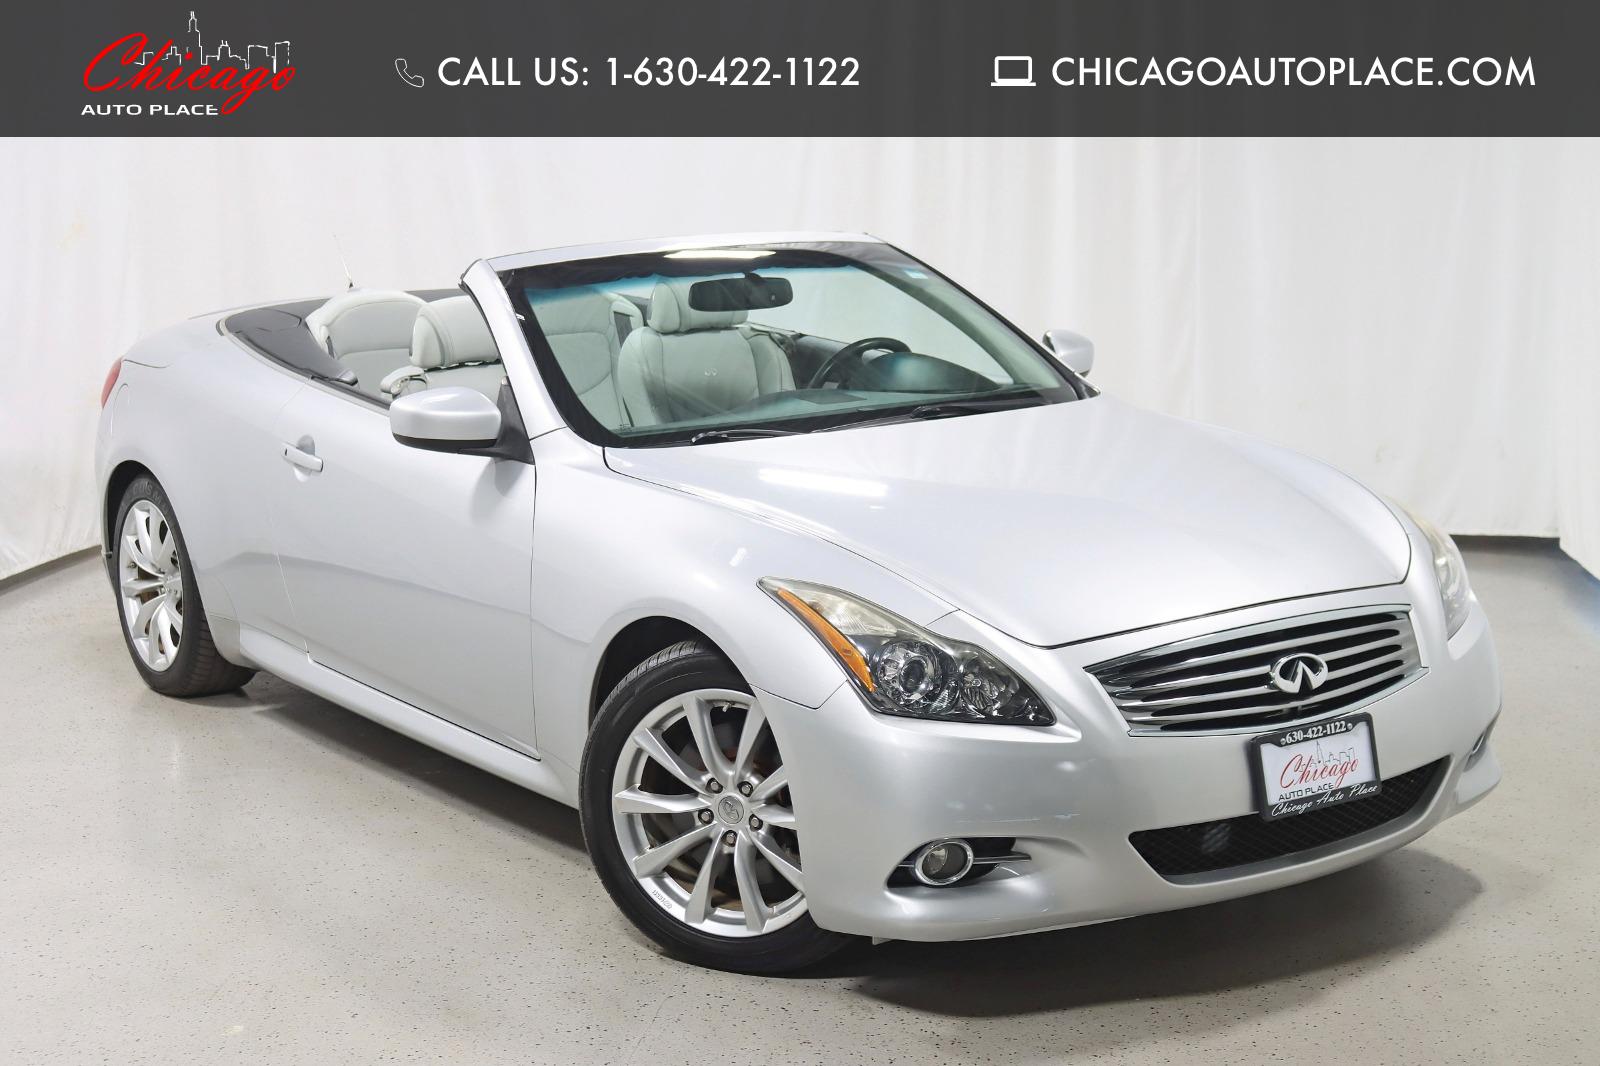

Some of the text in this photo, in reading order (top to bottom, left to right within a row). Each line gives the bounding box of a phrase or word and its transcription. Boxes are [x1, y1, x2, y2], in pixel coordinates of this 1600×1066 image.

[1286, 720, 1347, 744] 630-422-1122
[1280, 753, 1358, 789] Chicago
[1271, 783, 1378, 817] Chicago Auto Place
[1279, 782, 1334, 801] AUTO PLACE
